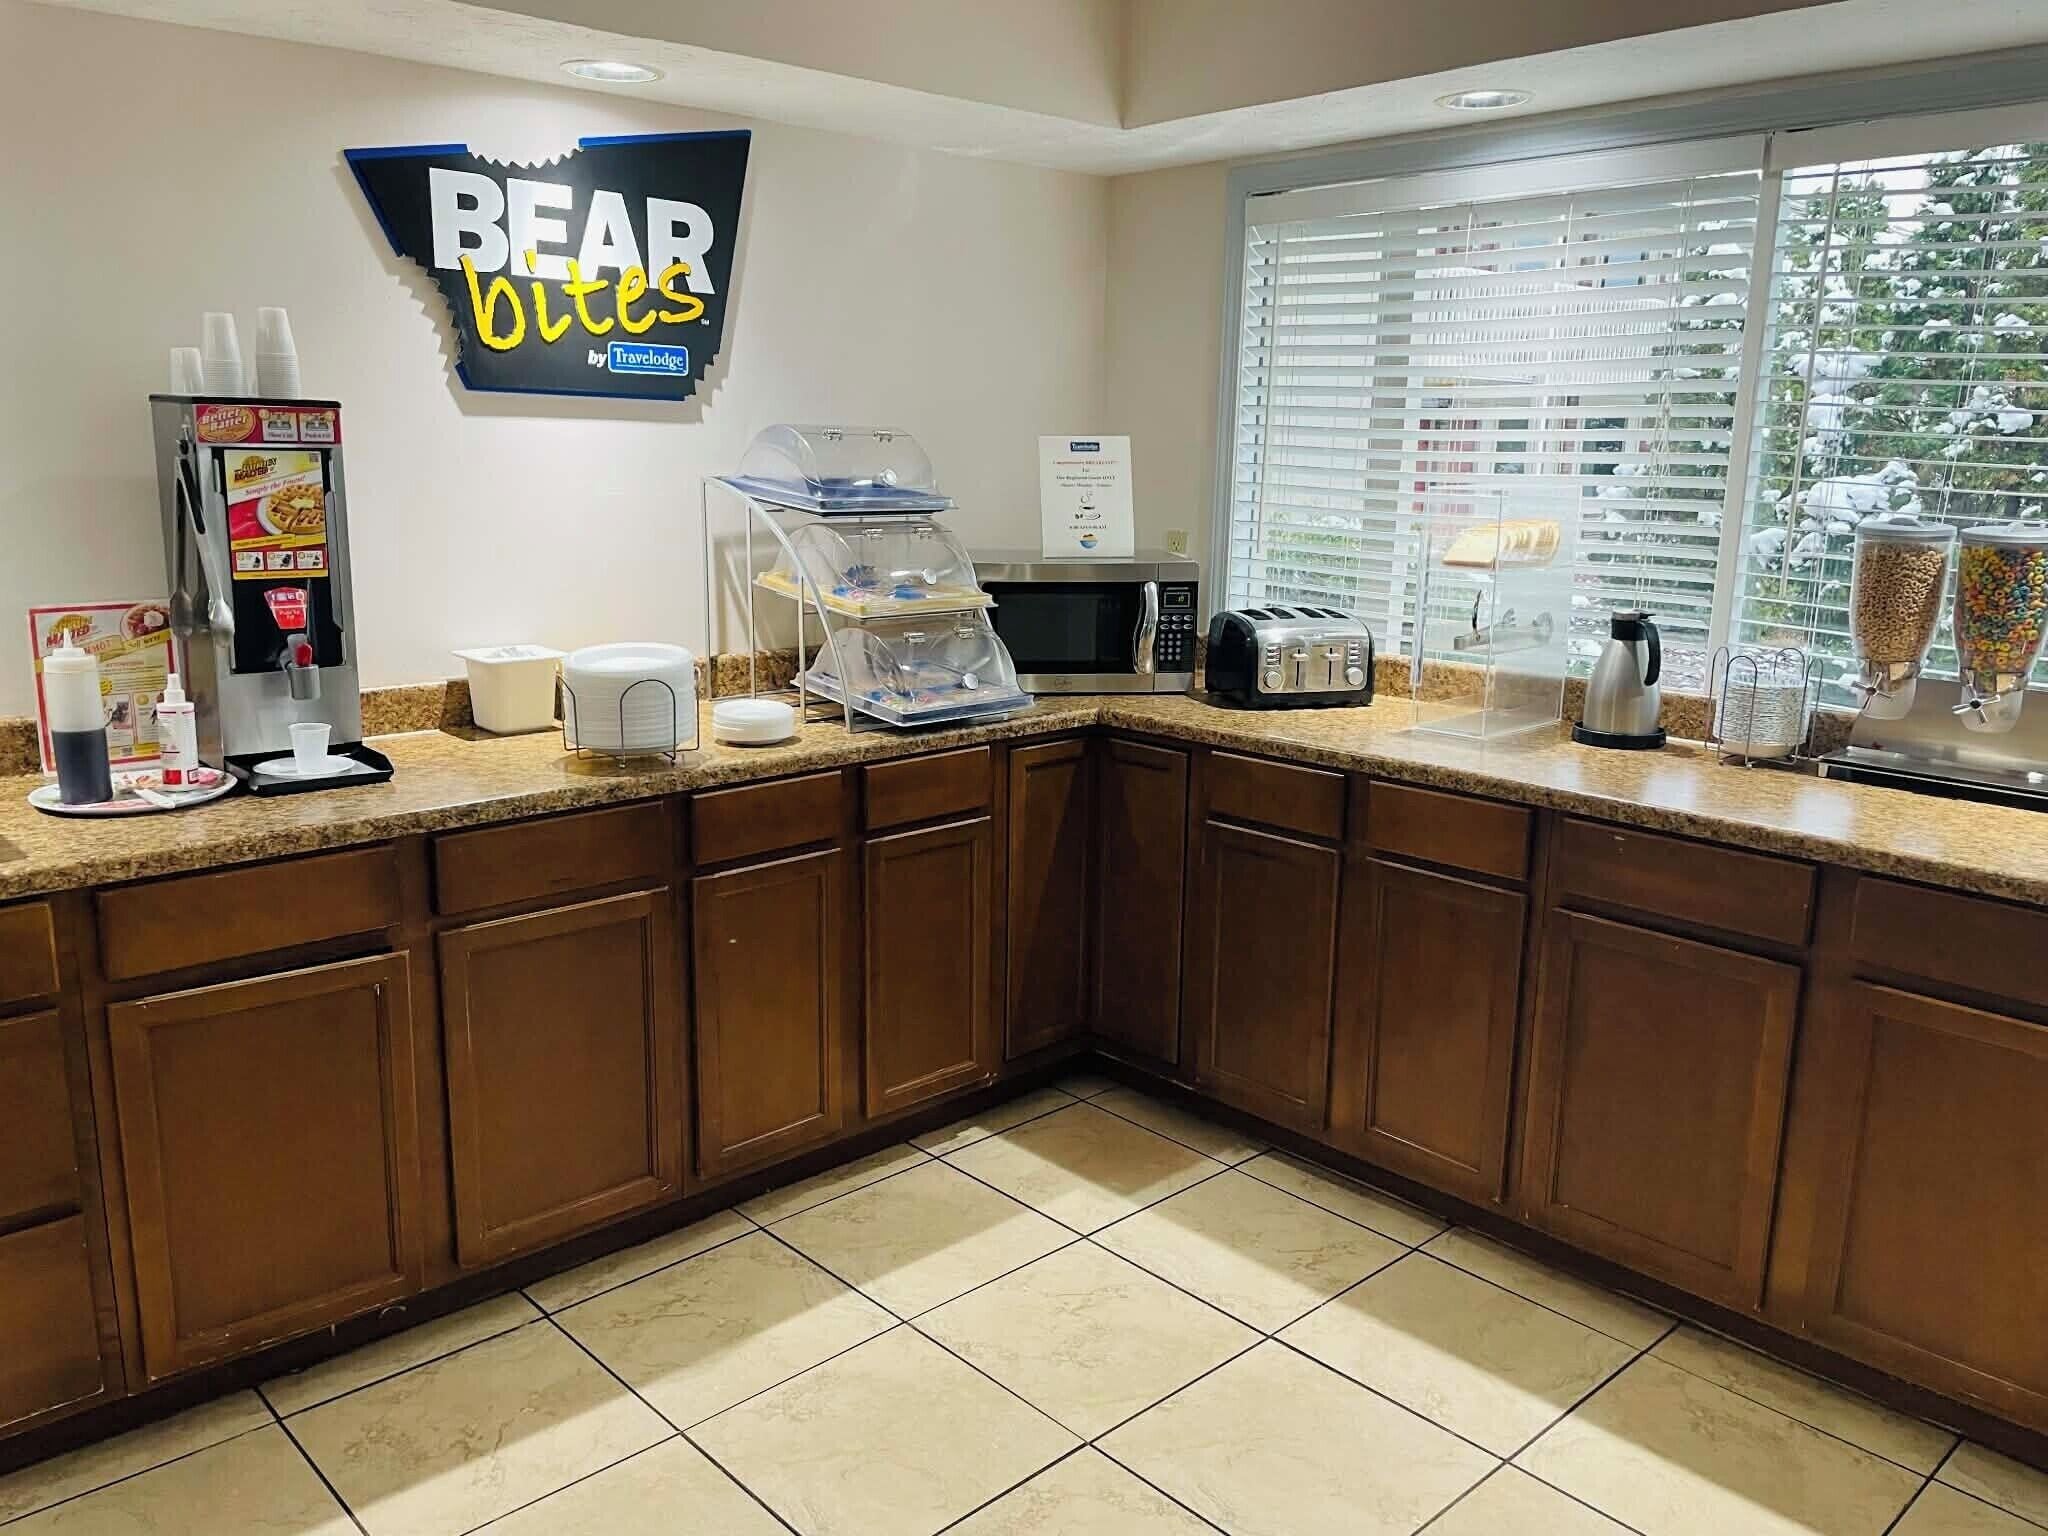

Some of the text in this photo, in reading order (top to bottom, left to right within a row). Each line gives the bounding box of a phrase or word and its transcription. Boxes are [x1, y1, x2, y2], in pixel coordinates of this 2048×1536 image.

[429, 167, 715, 294] BEAR
[459, 249, 705, 350] bites
[588, 347, 684, 371] by Travelodge
[202, 407, 240, 425] Better
